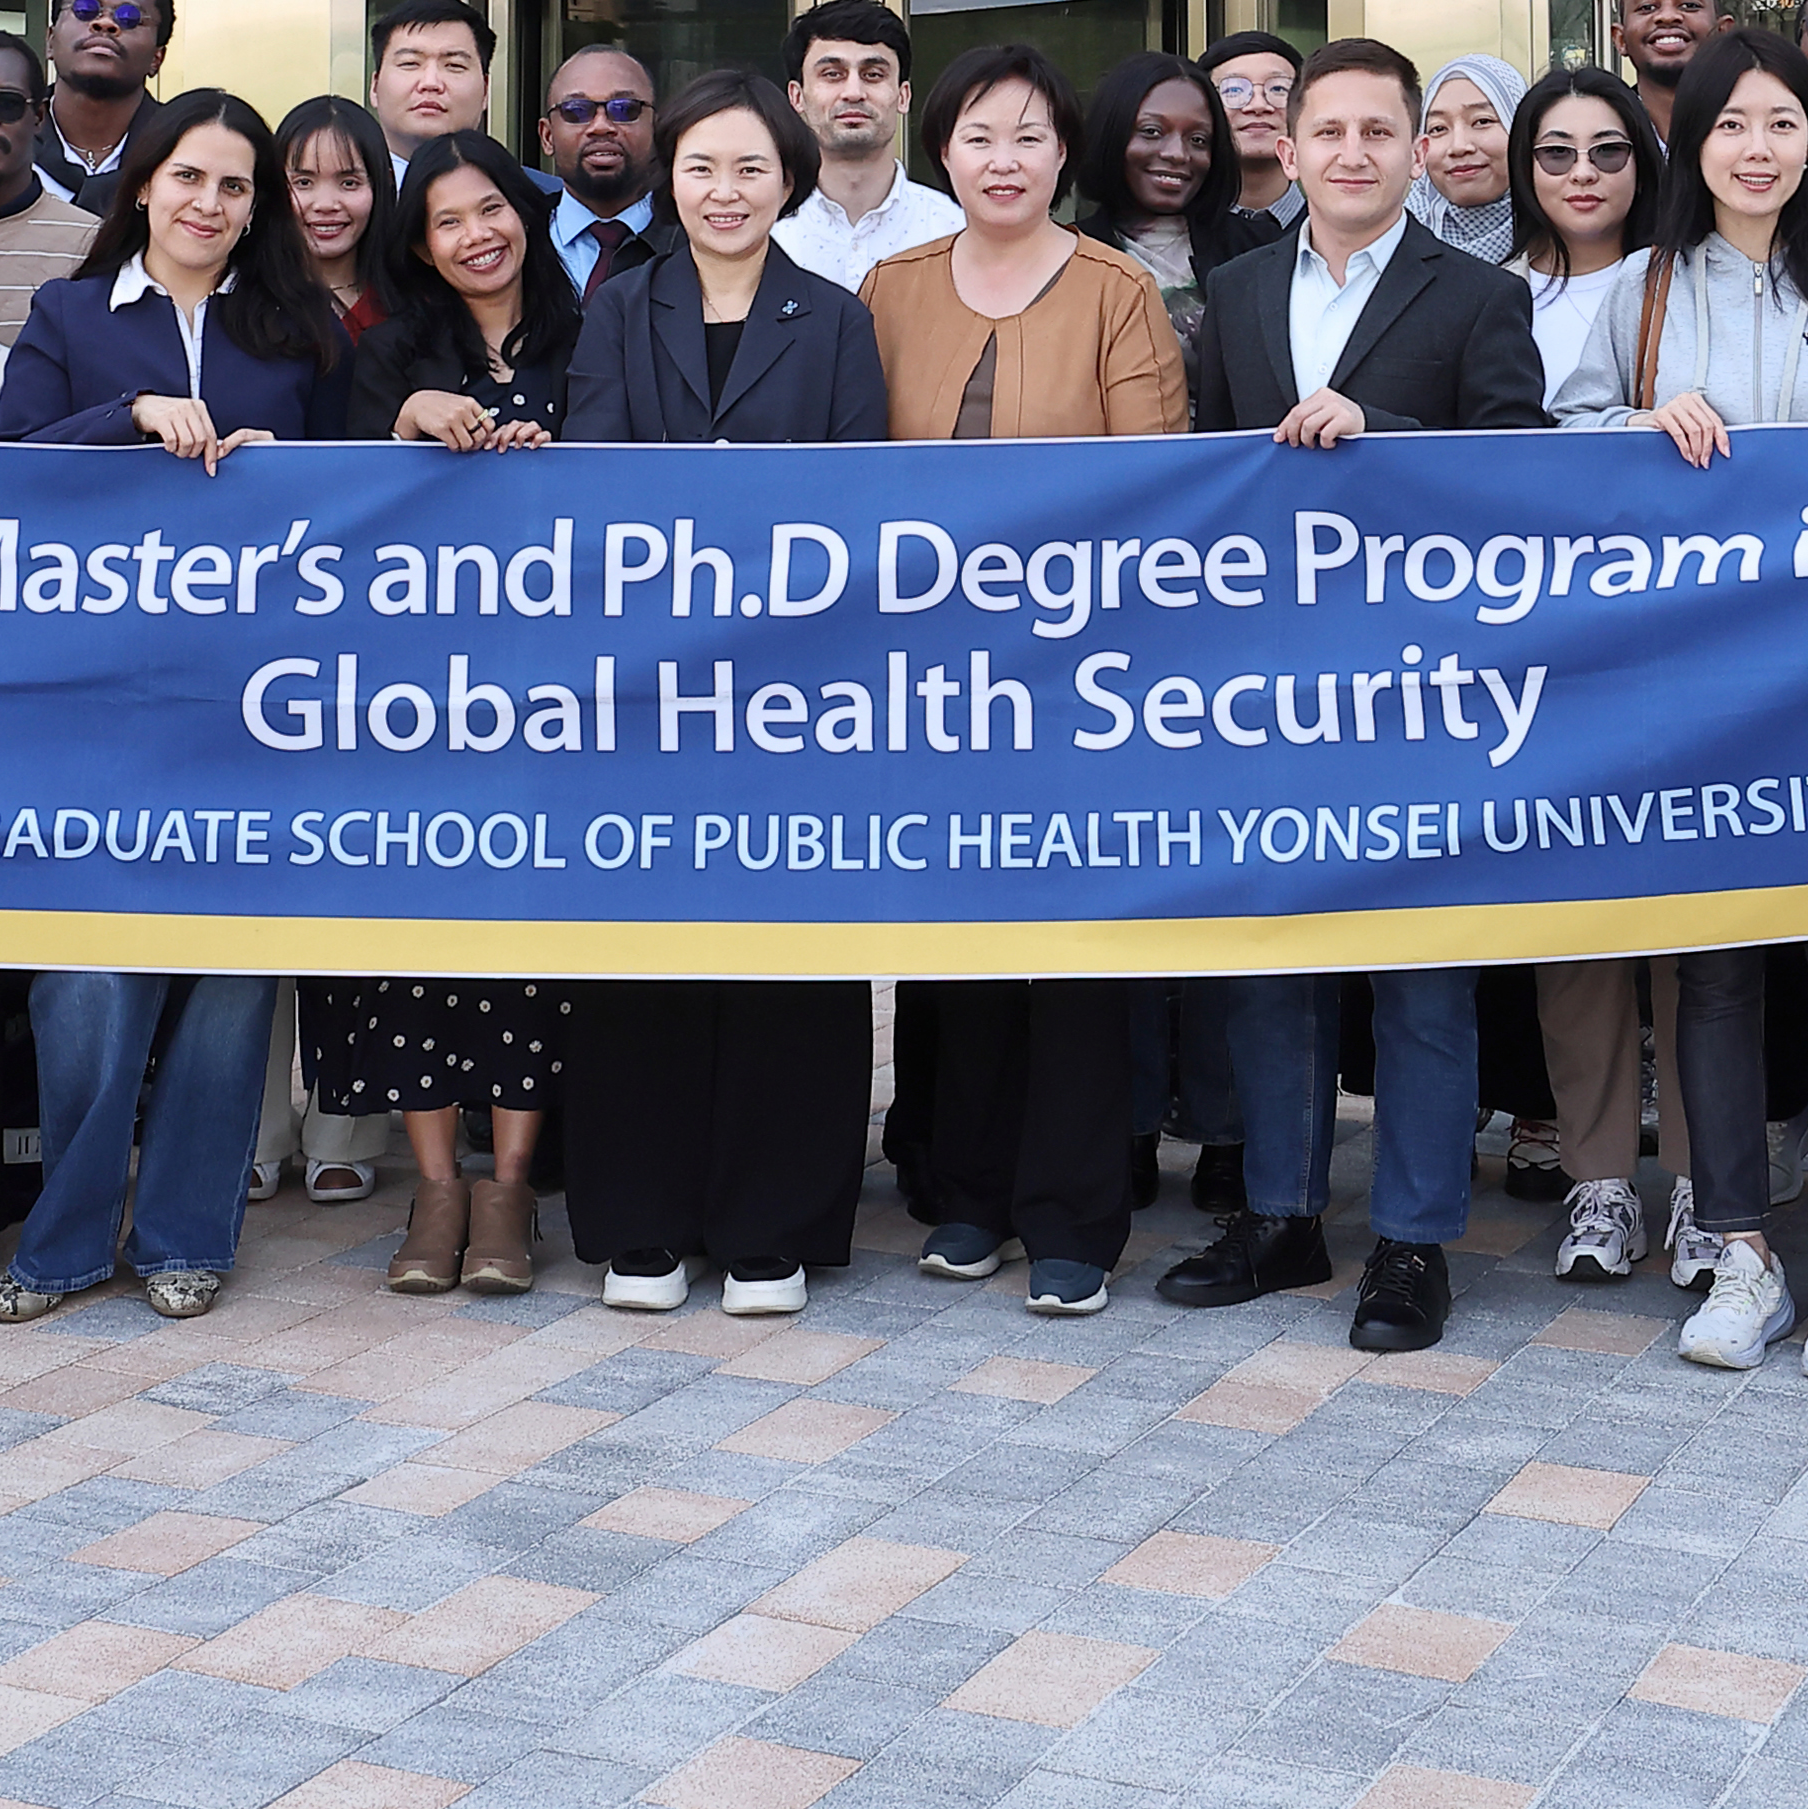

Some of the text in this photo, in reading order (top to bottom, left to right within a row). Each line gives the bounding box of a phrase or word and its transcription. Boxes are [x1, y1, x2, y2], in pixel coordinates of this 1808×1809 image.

[367, 517, 575, 618] and
[603, 517, 850, 619] Ph.D
[877, 519, 1268, 640] Degree
[1294, 510, 1765, 626] Program
[241, 643, 1549, 769] Global Health Security
[288, 810, 567, 869] SCHOOL
[583, 813, 674, 870] OF
[693, 813, 929, 871] PUBLIC
[948, 809, 1202, 870] HEALTH
[1216, 801, 1461, 865] YONSEI
